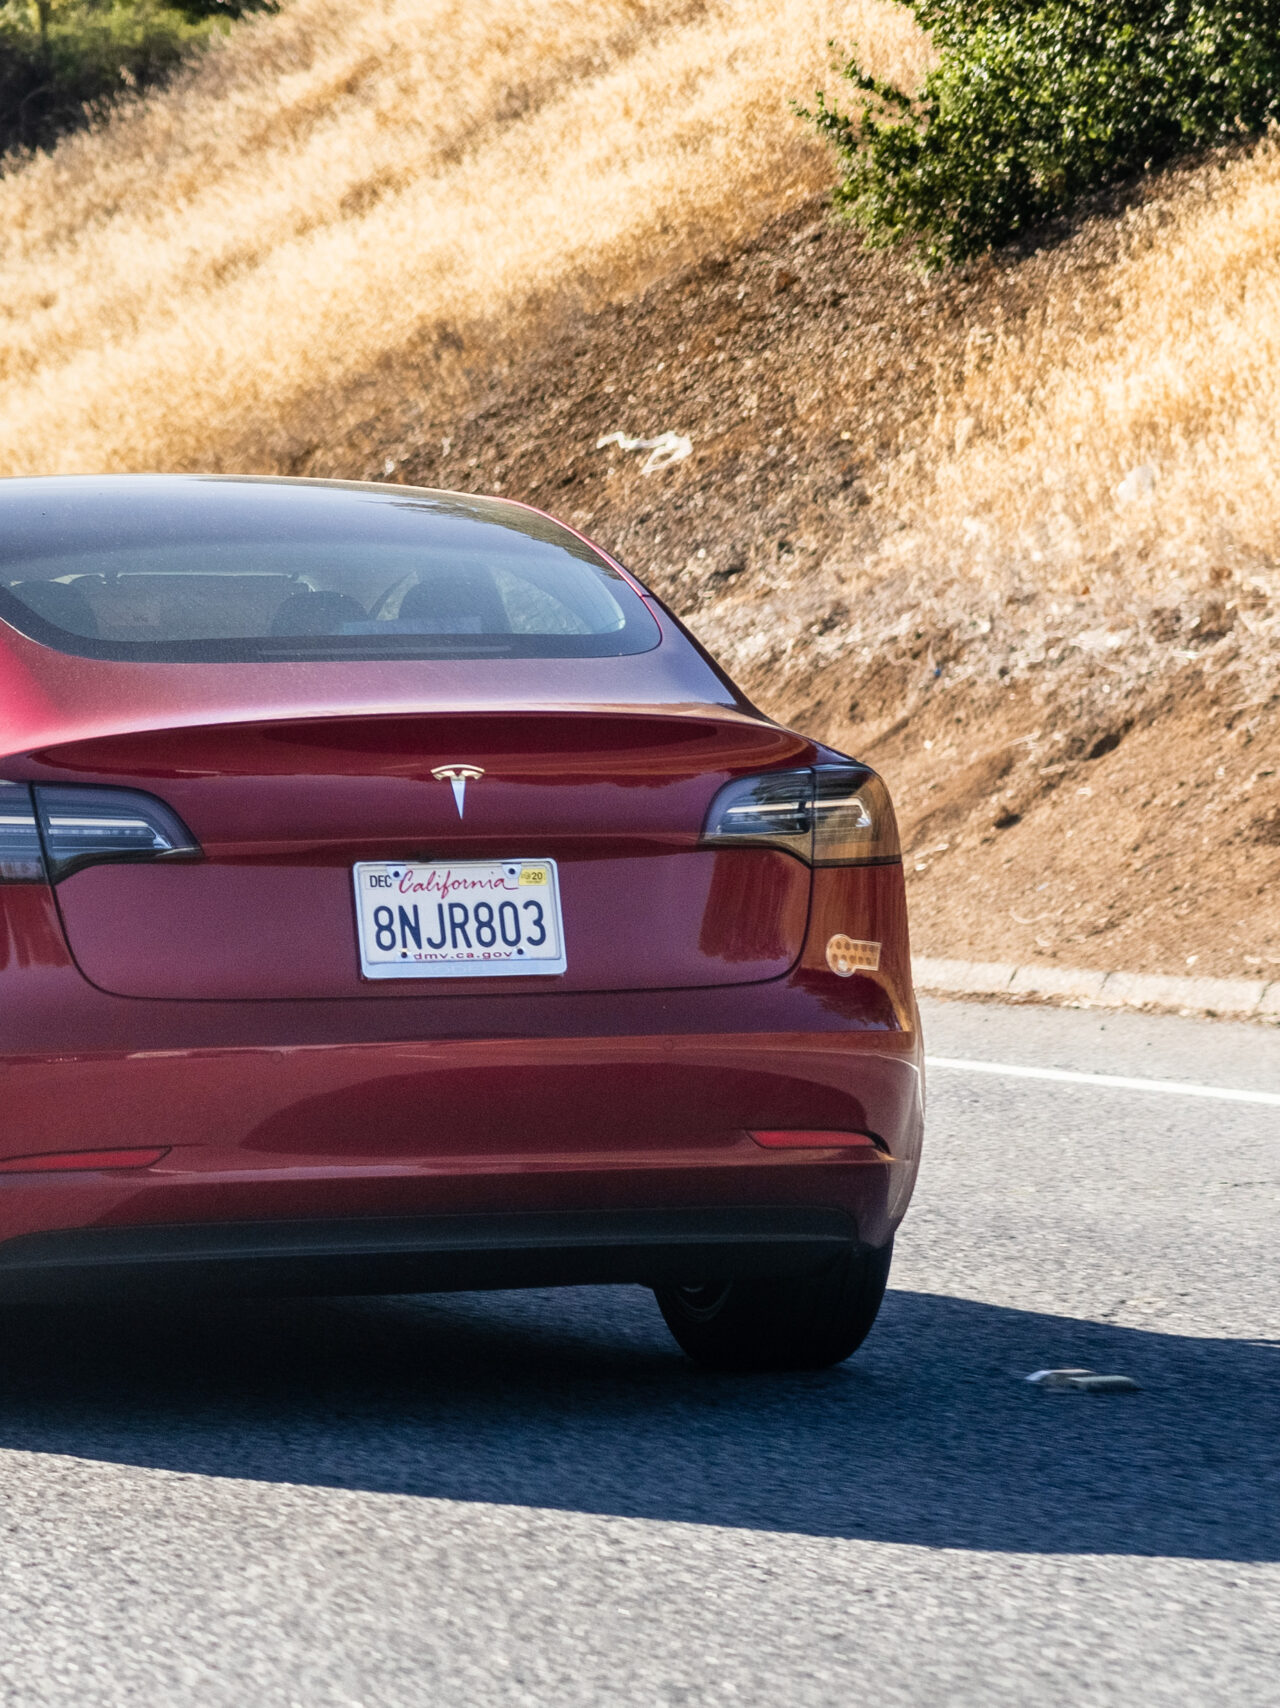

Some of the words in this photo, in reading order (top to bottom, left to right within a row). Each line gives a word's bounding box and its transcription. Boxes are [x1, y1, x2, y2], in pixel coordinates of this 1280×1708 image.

[369, 874, 392, 888] DEC
[531, 871, 543, 880] 20
[398, 870, 519, 899] California
[373, 900, 547, 951] 8NJR803
[413, 951, 513, 960] dmv.ca.gov
